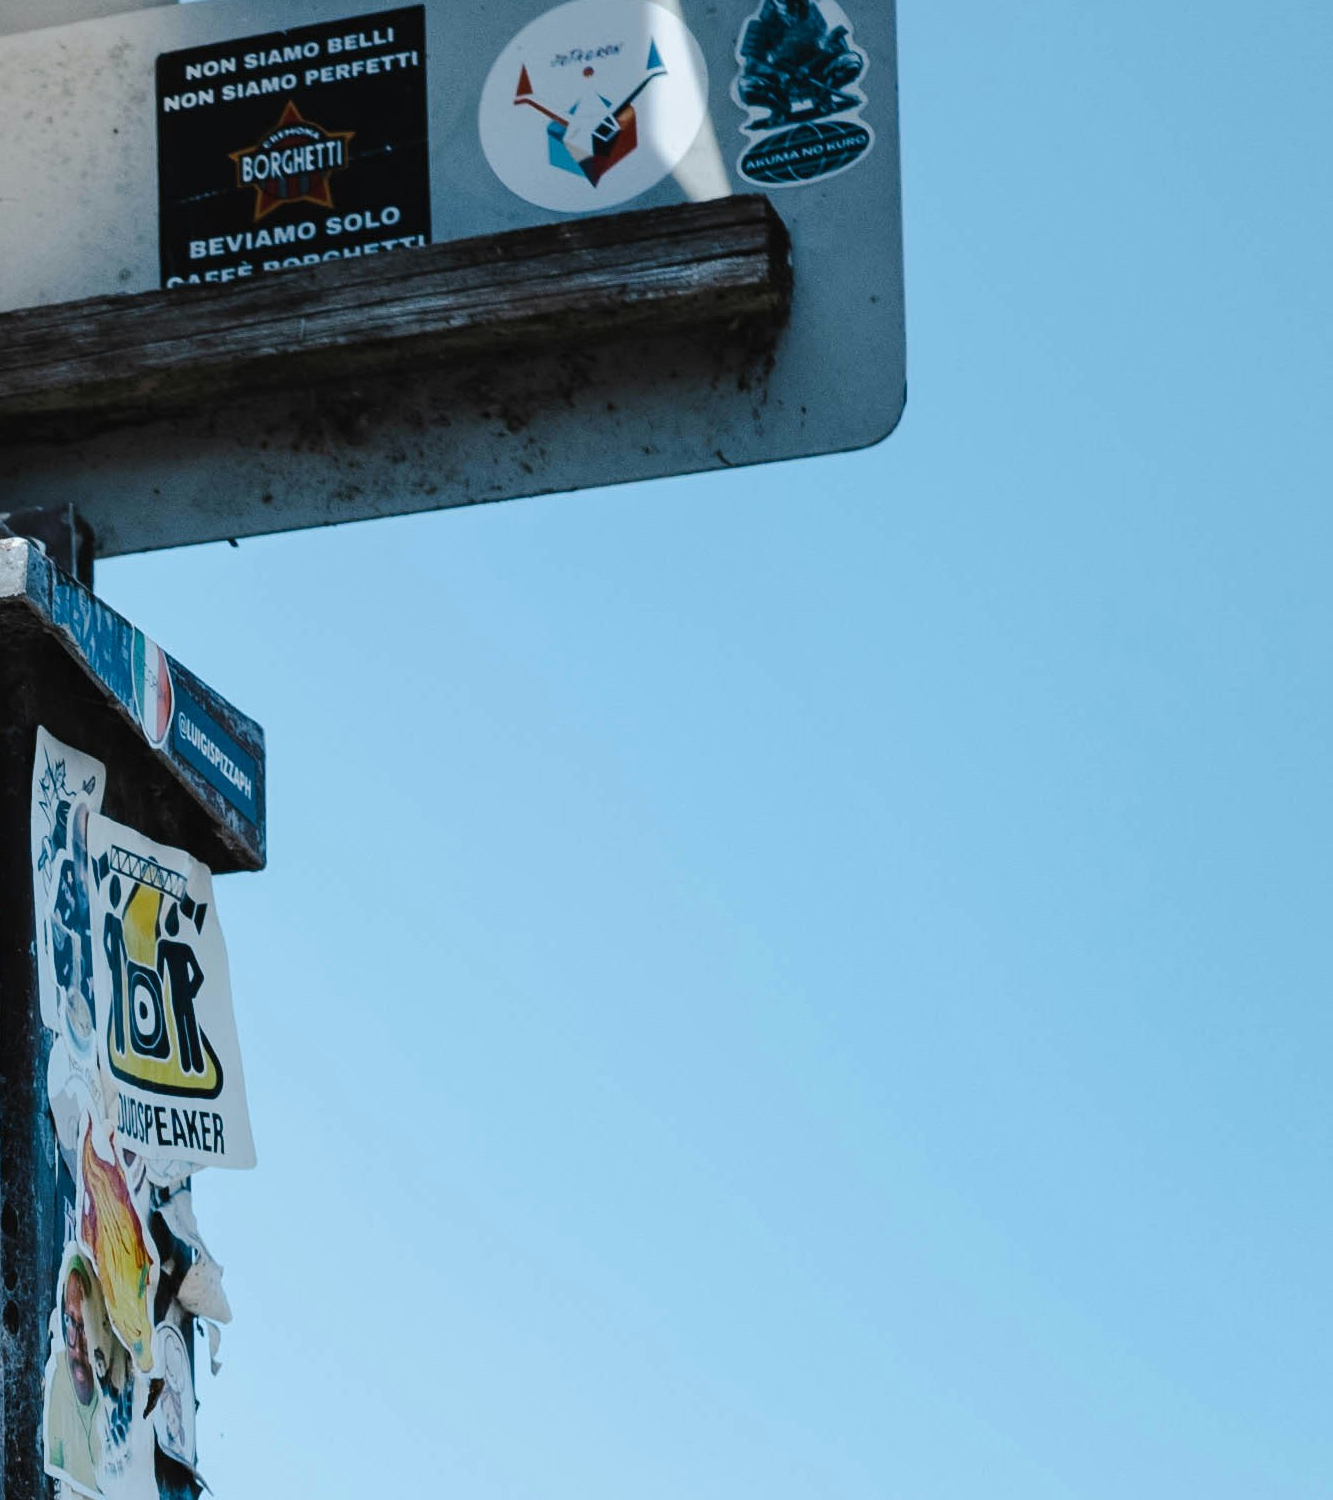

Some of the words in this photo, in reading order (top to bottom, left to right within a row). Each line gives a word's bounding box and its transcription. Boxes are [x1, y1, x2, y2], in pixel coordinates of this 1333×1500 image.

[186, 58, 236, 80] NON
[244, 42, 319, 70] SIAMO
[327, 27, 394, 54] BELLI
[164, 89, 214, 113] NON
[222, 74, 297, 100] SIAMO
[305, 51, 418, 86] PERFETTI
[242, 141, 342, 182] BORGHETTI
[189, 222, 316, 258] BEVIAMO
[326, 207, 400, 234] SOLO
